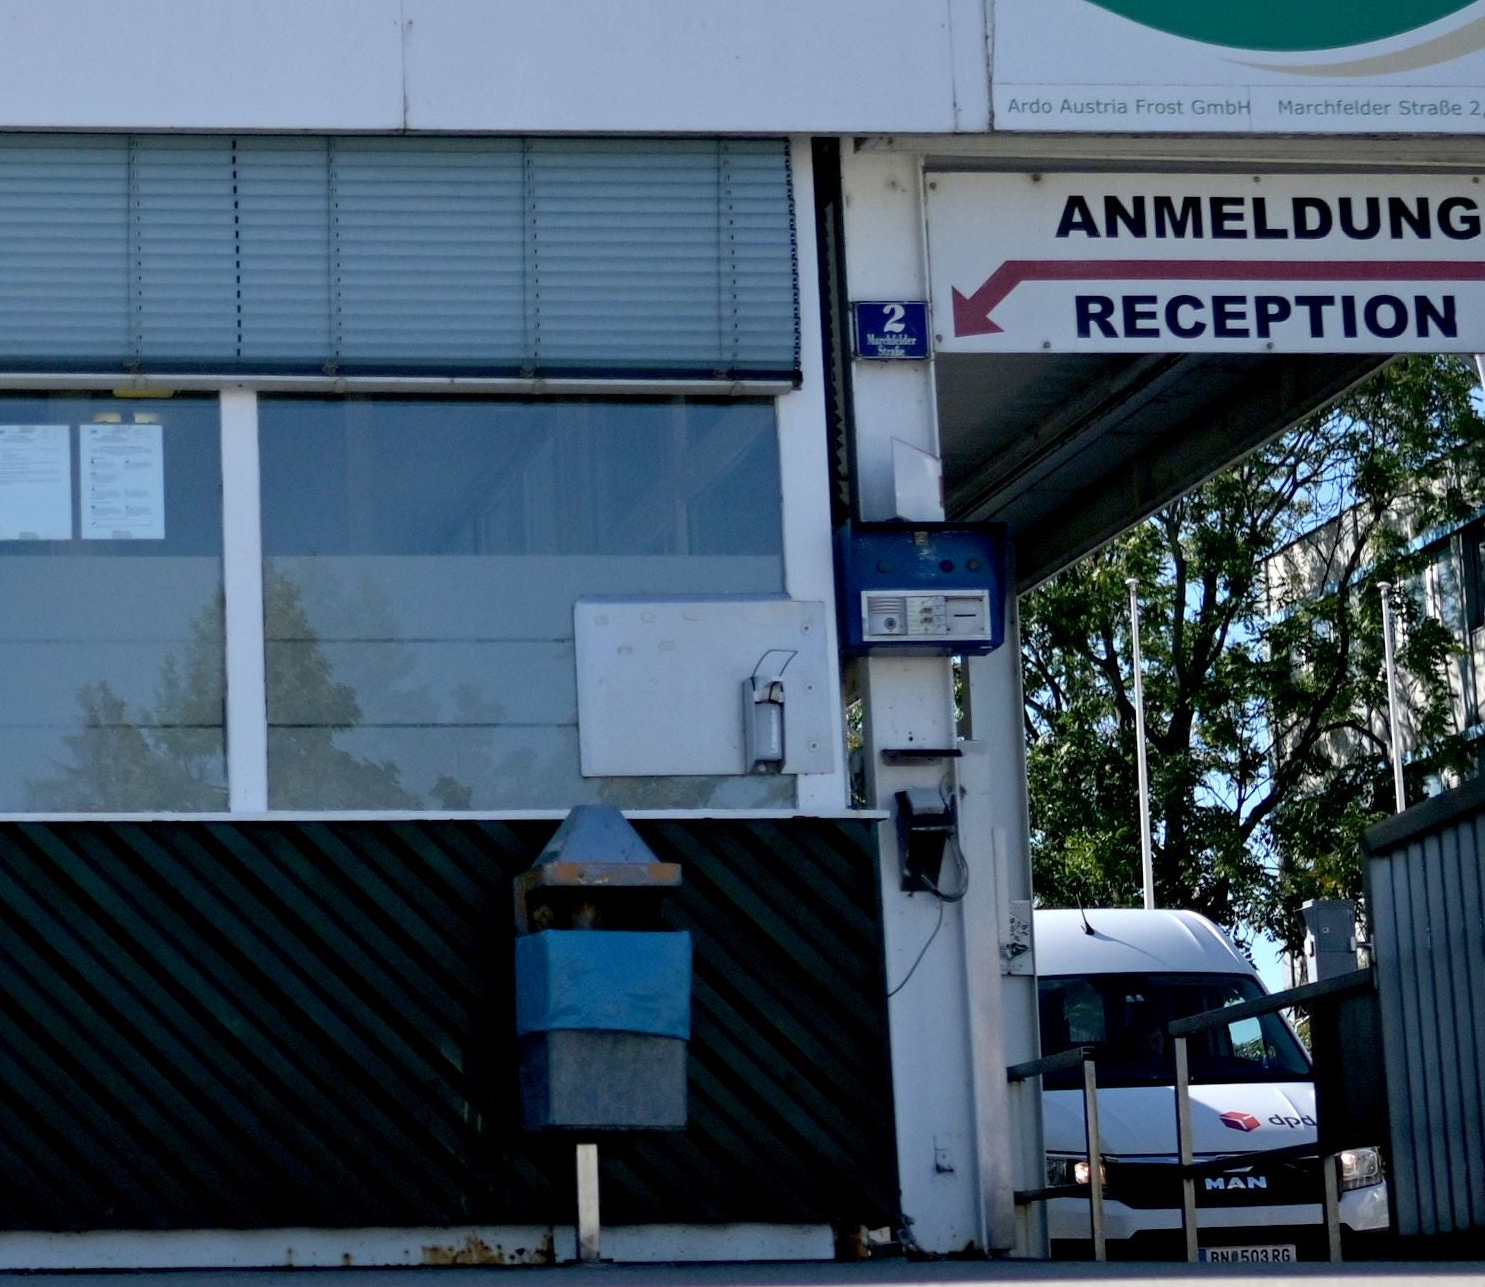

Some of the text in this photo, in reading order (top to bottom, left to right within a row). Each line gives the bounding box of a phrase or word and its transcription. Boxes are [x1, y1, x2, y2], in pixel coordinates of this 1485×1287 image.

[1007, 98, 1251, 116] Ardo Austria Frost GmbH
[1278, 99, 1391, 116] Marchfelder
[1399, 99, 1463, 116] Straße
[1055, 194, 1482, 240] ANMELDUNG
[882, 304, 906, 333] 2
[1074, 294, 1459, 339] RECEPTION
[866, 334, 917, 346] Marchfelder
[877, 344, 906, 357] Straße
[1268, 1113, 1317, 1129] dpd
[1204, 1175, 1268, 1190] MAN
